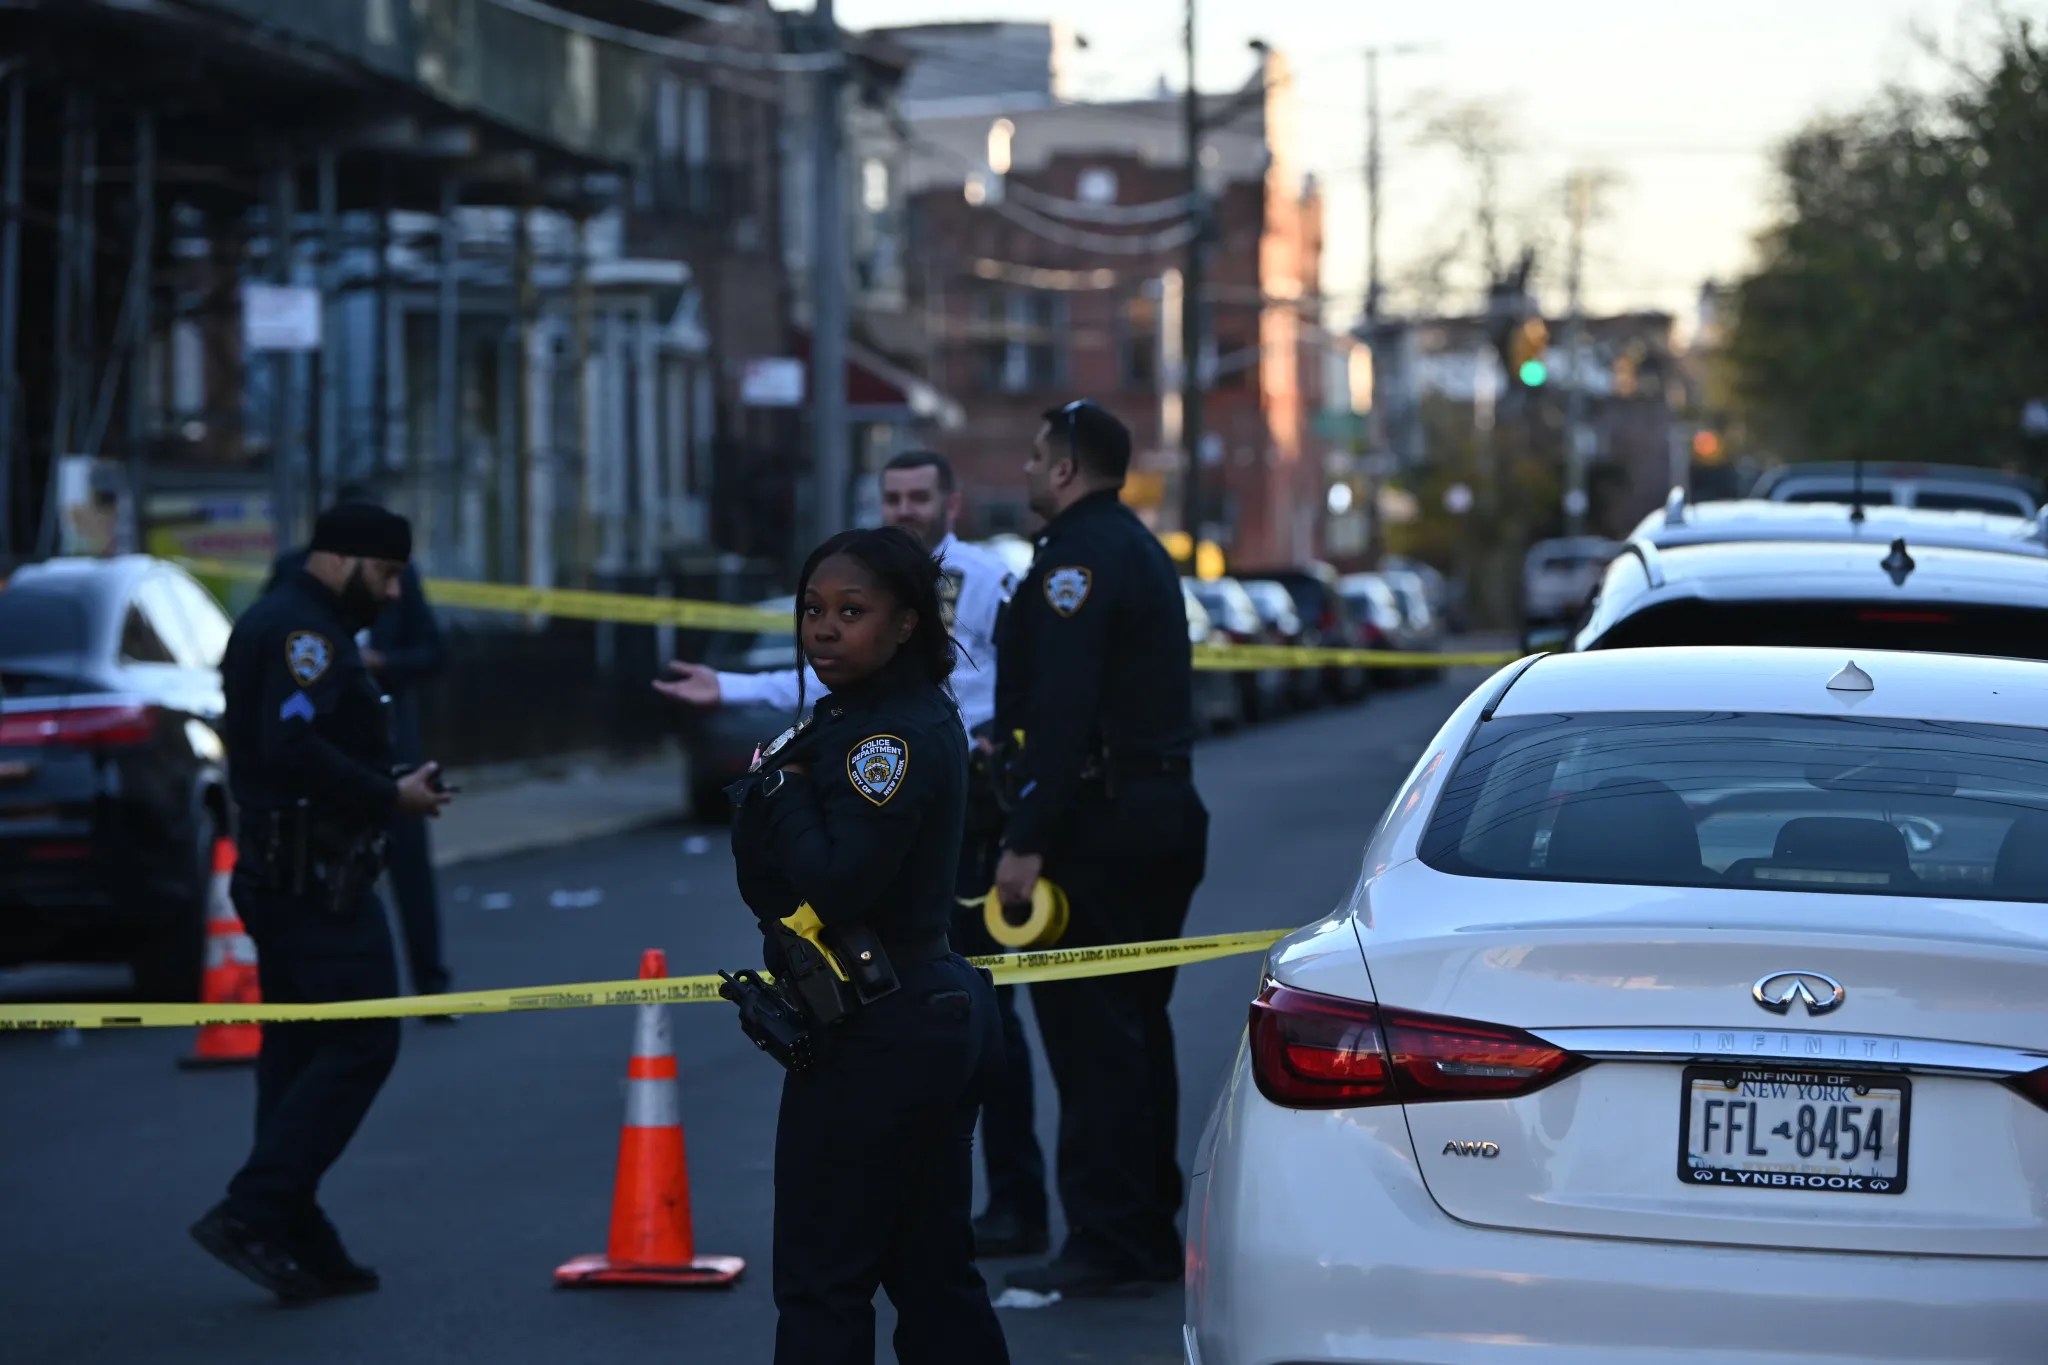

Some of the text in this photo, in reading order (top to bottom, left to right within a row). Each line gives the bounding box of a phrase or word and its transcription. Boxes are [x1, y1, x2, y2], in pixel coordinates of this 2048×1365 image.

[861, 739, 890, 751] POLICE
[852, 746, 902, 764] DEPARTMENT
[852, 771, 863, 785] CITY
[862, 785, 872, 794] OF
[883, 781, 896, 796] NEW
[893, 760, 904, 780] YORK
[1692, 1031, 1900, 1060] INFINITI
[1742, 1071, 1852, 1085] INFINITI OF
[1741, 1082, 1852, 1103] NEW YORK
[1703, 1100, 1883, 1161] FFL 8454
[1442, 1139, 1500, 1158] AWD
[1720, 1171, 1863, 1190] LYNBROOK
